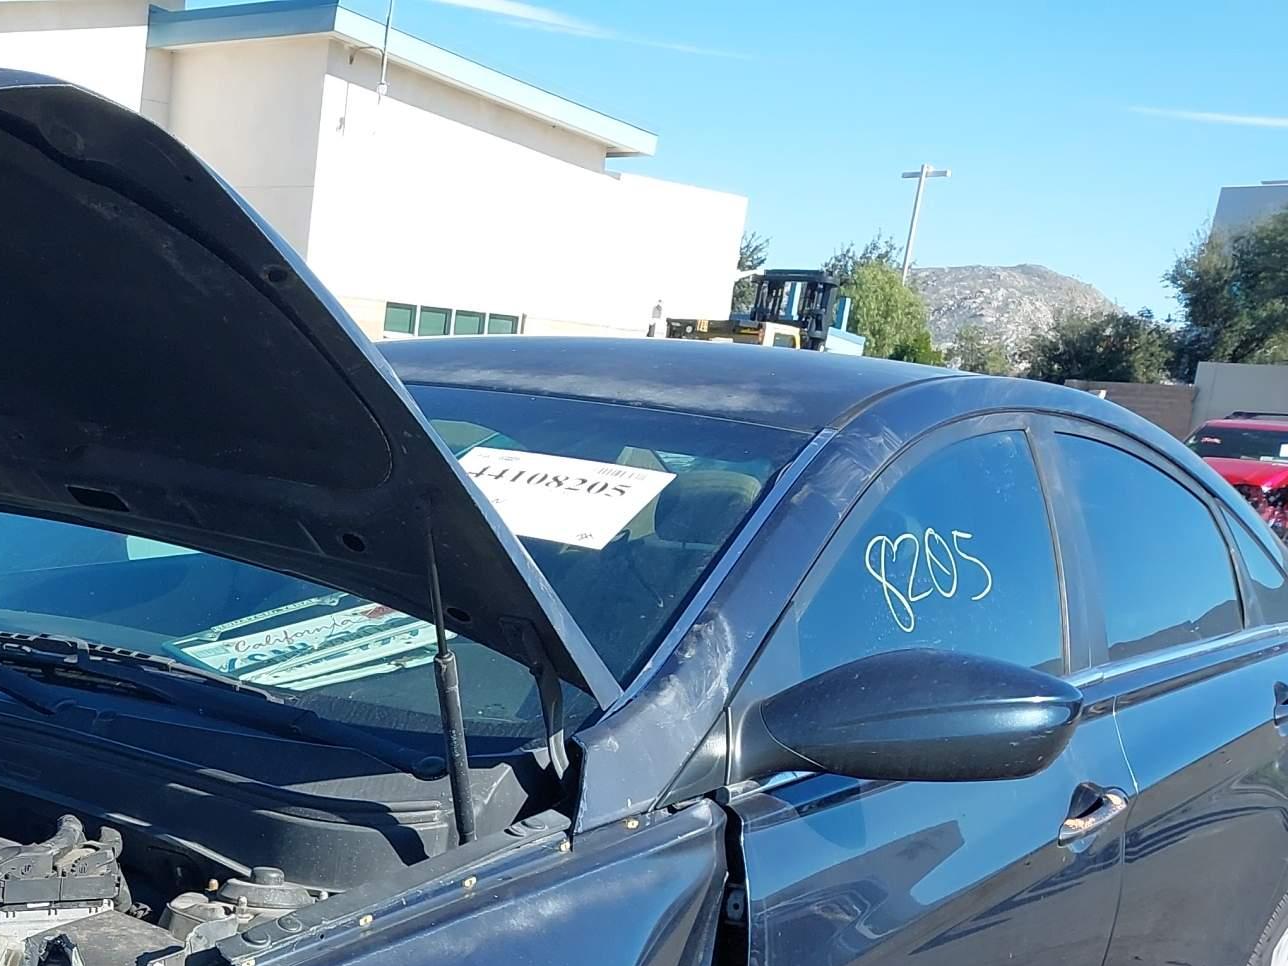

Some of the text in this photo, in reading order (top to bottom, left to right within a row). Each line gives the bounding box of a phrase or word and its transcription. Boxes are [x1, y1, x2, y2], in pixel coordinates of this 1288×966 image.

[468, 465, 633, 498] 44108205
[865, 527, 993, 633] 8205
[233, 616, 359, 653] California
